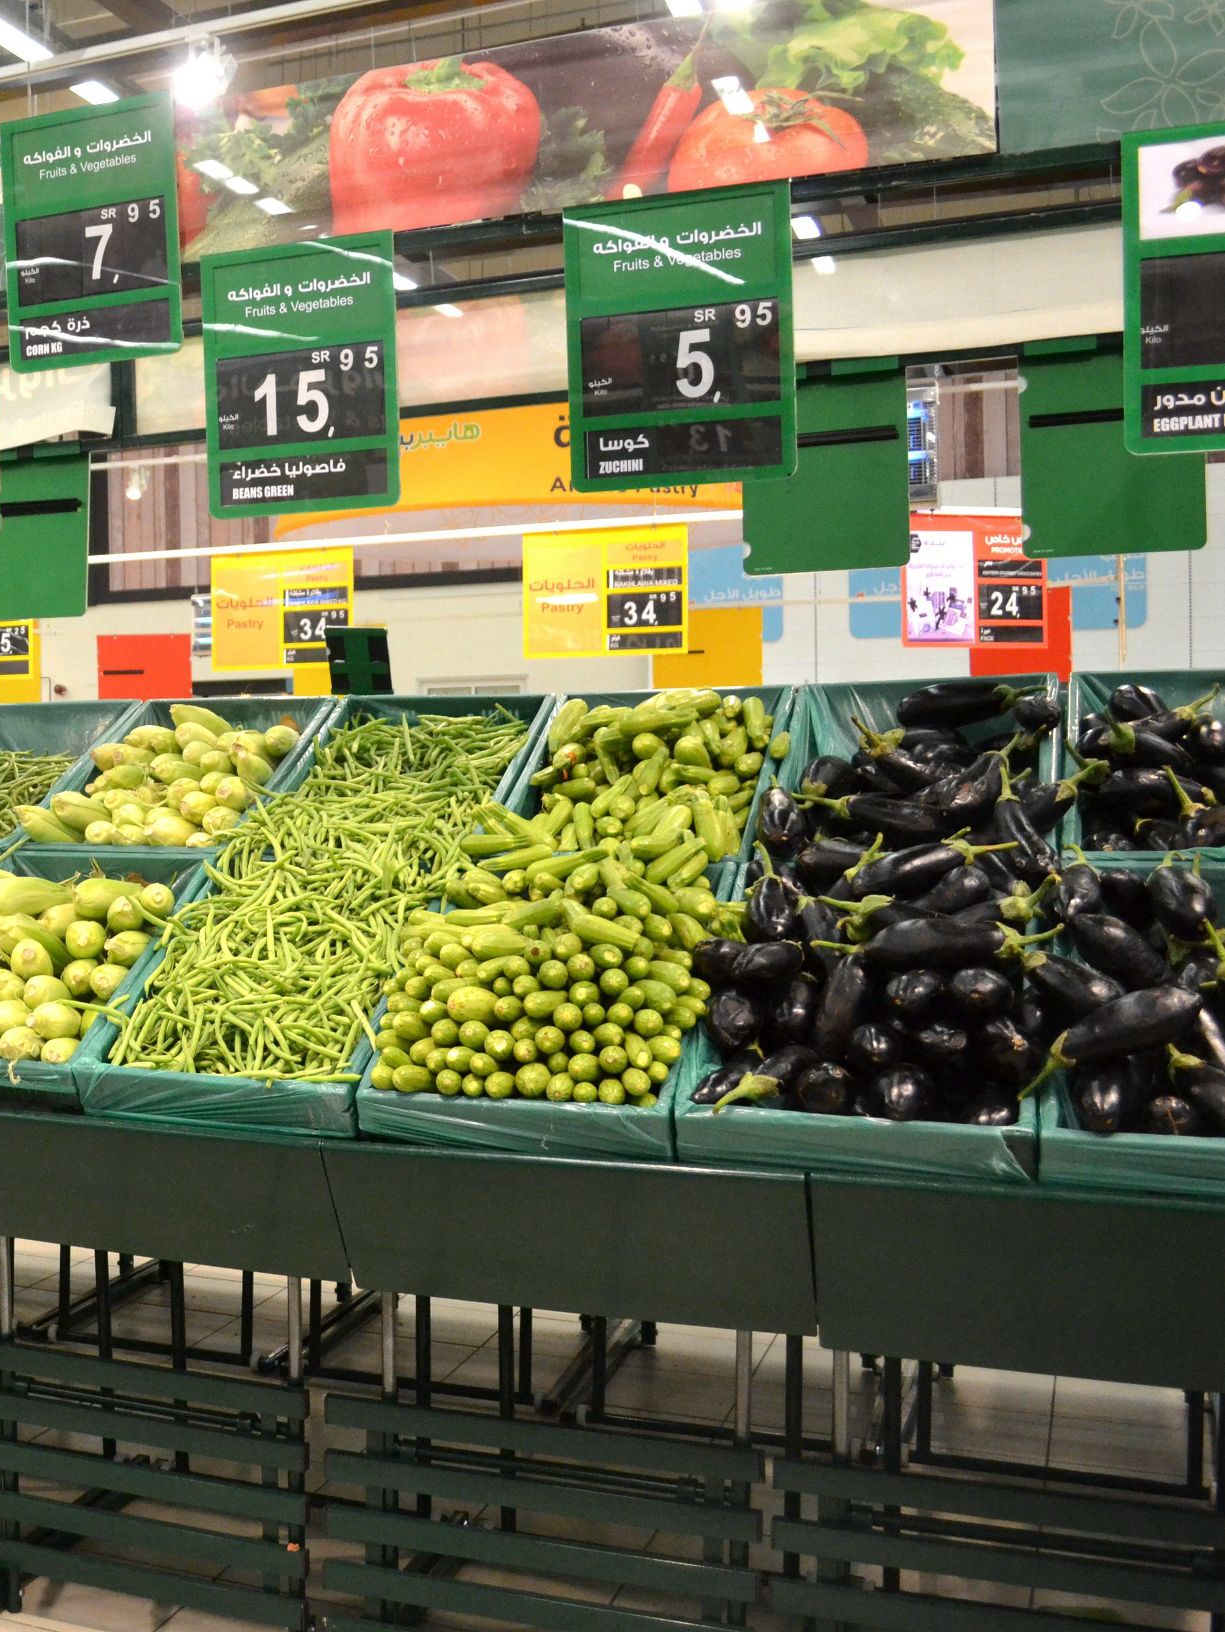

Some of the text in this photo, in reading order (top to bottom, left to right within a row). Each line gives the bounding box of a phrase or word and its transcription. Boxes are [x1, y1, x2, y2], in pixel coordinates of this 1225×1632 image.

[87, 130, 151, 153] الخضروات
[24, 146, 71, 165] الفواكه
[39, 154, 136, 180] Fruits & Vegetables
[101, 208, 116, 220] SR
[677, 221, 762, 245] الخضروات
[613, 247, 741, 273] Fruits & Vegetables
[299, 272, 370, 292] الخضروات
[228, 283, 282, 301] الفواكه
[245, 296, 353, 317] Fruits & Vegetables
[67, 316, 90, 332] ذرة
[694, 309, 716, 323] SR
[1145, 336, 1161, 344] Kilo
[26, 342, 62, 356] CORN KG
[312, 351, 330, 364] SR
[589, 378, 612, 388] الكيلو
[1154, 394, 1206, 410] مدور
[1153, 414, 1220, 432] EGGPLANT
[600, 434, 649, 453] كوسا
[233, 459, 346, 481] فاصوليا خضراء
[599, 459, 643, 474] ZUCHINI
[232, 485, 294, 499] BEANS GREEN
[529, 578, 594, 592] الحلويات
[228, 620, 264, 629] Pastry
